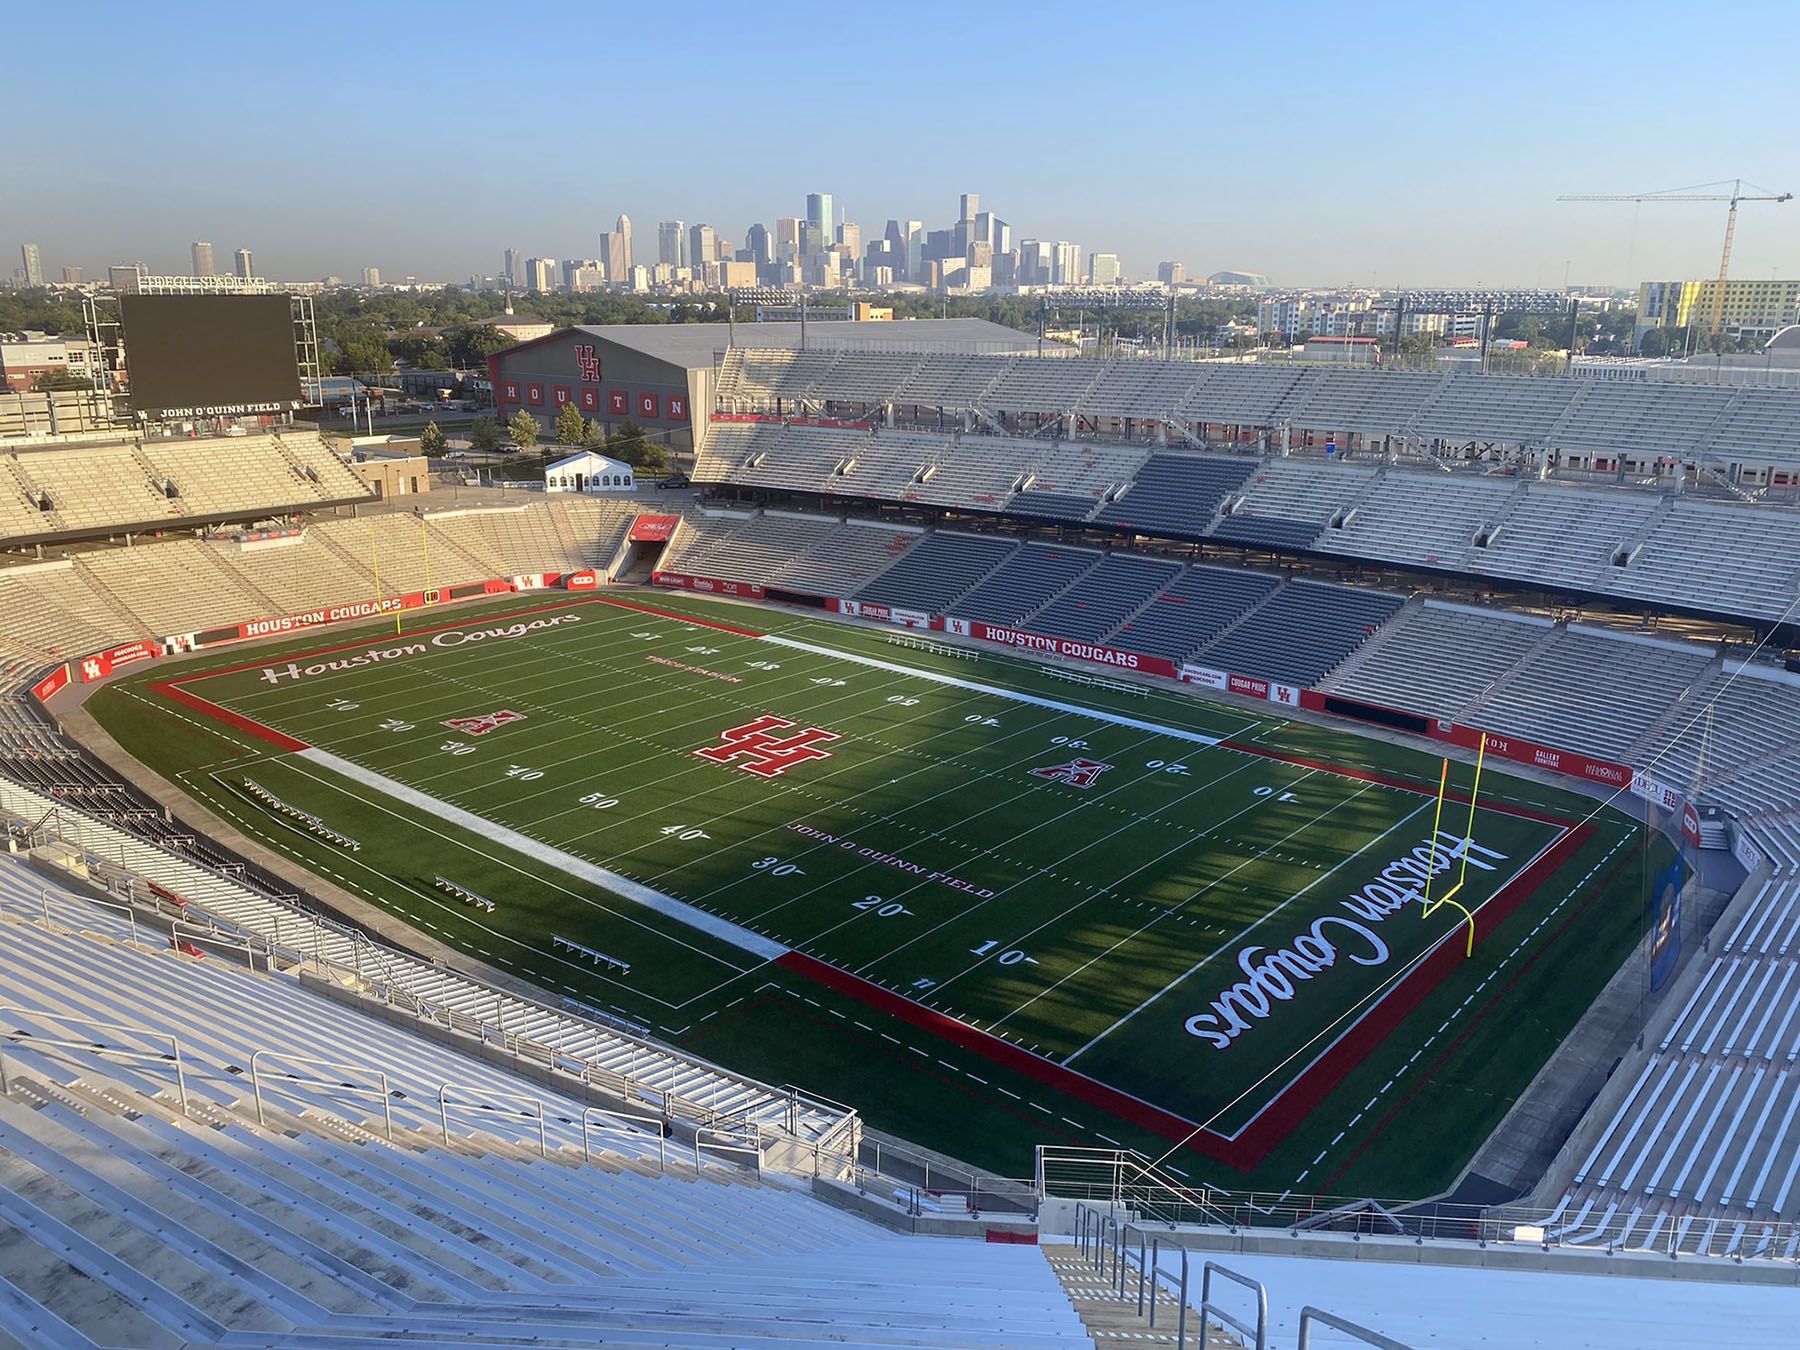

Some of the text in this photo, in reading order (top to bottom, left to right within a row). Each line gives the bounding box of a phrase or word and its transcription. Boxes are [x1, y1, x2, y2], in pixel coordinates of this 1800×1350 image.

[575, 345, 600, 382] UH
[507, 386, 682, 414] HOUSTON
[160, 402, 281, 418] JOHN O'QUINN FIELD
[246, 599, 401, 636] HOUSTON COUGARS
[260, 613, 582, 685] Houston Cougars
[986, 626, 1138, 668] HOUSTON COUGARS
[83, 659, 101, 678] UH
[1231, 678, 1251, 690] COUGAR
[1251, 682, 1267, 693] PRIDE
[326, 699, 360, 711] 10
[887, 695, 920, 706] 50
[378, 718, 416, 732] 20
[964, 714, 1001, 727] 40
[440, 740, 477, 756] 30
[692, 714, 843, 778] UH
[1050, 736, 1089, 750] 30
[1536, 750, 1561, 762] GALLERY
[505, 764, 545, 781] 40
[1146, 759, 1190, 775] 20
[579, 792, 619, 809] 50
[1253, 786, 1300, 803] 10
[660, 824, 704, 842] 40
[752, 856, 797, 877] 30
[786, 823, 841, 845] JOHN
[858, 847, 927, 875] QUINN
[927, 871, 995, 899] FIELD
[851, 895, 903, 918] 20
[1185, 830, 1510, 1049] Houston Cougars
[969, 940, 1025, 966] 10
